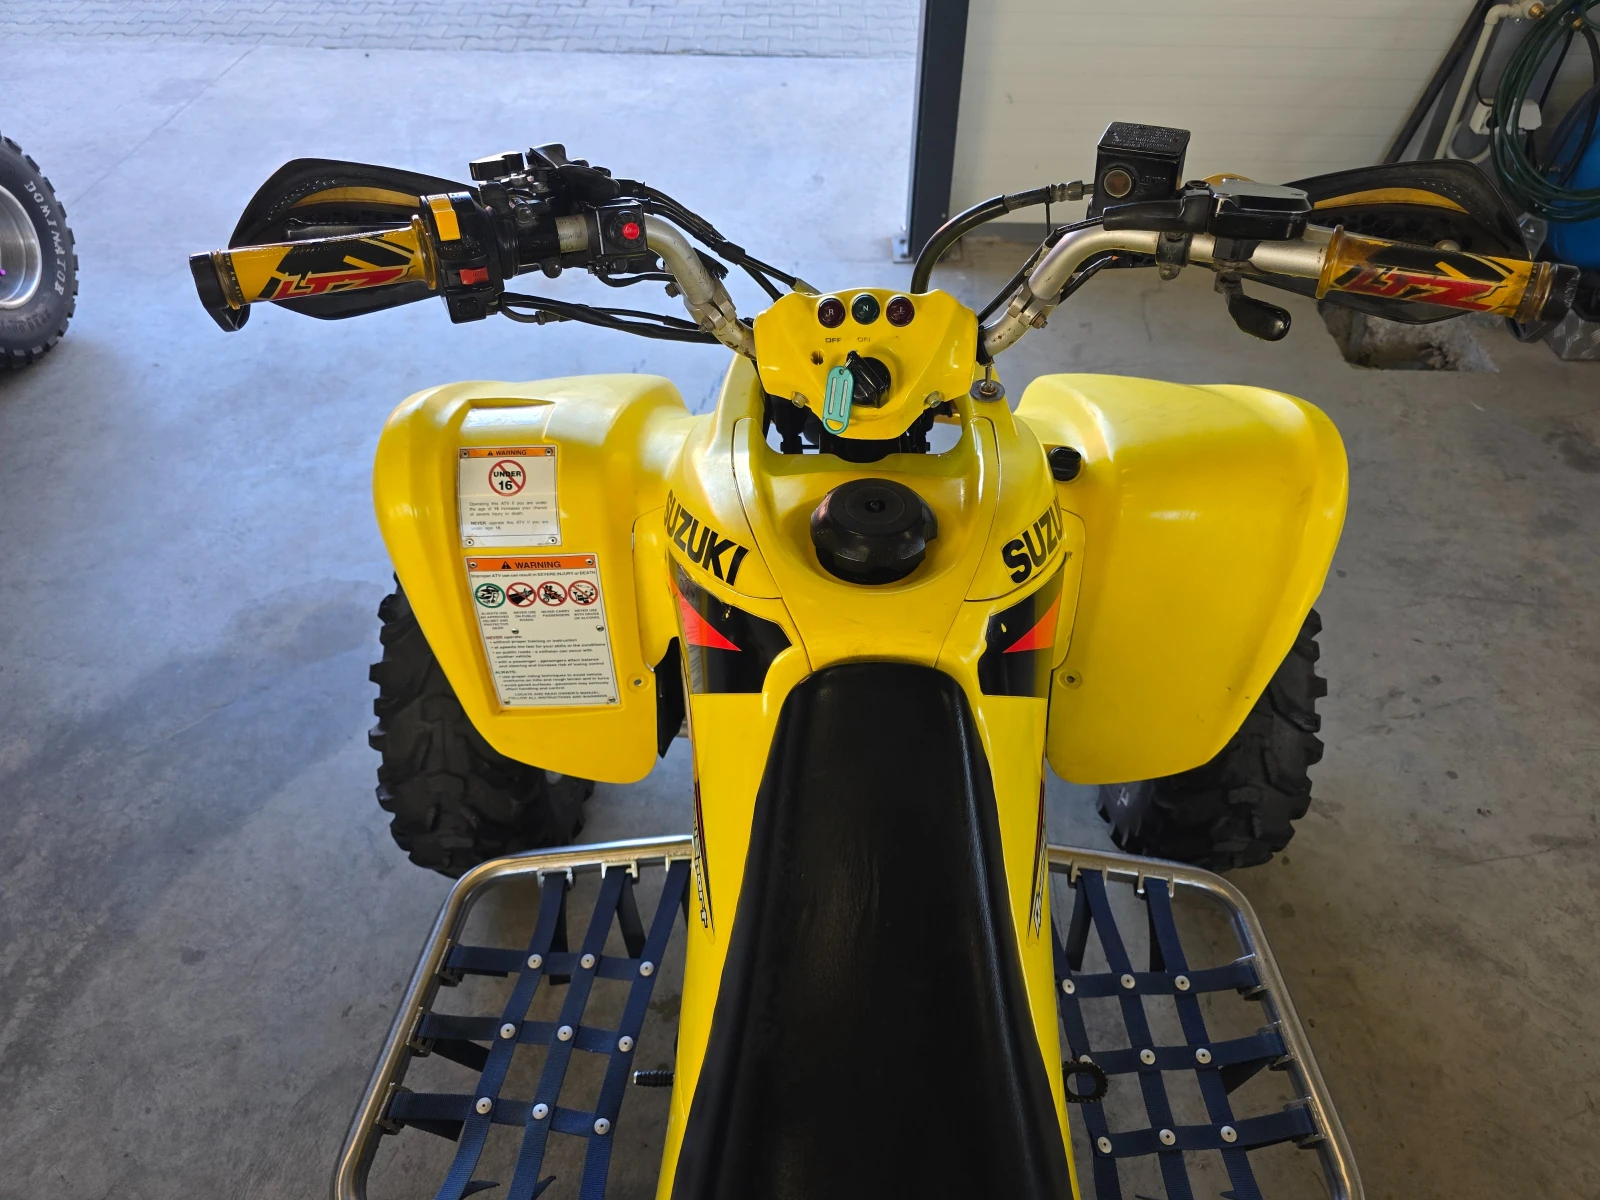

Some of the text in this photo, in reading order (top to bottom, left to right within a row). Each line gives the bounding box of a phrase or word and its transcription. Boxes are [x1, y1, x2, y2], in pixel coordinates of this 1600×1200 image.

[24, 180, 66, 296] DOMINATOR
[499, 480, 513, 490] 16
[664, 489, 750, 586] SUZUKI
[515, 561, 561, 569] WARNING
